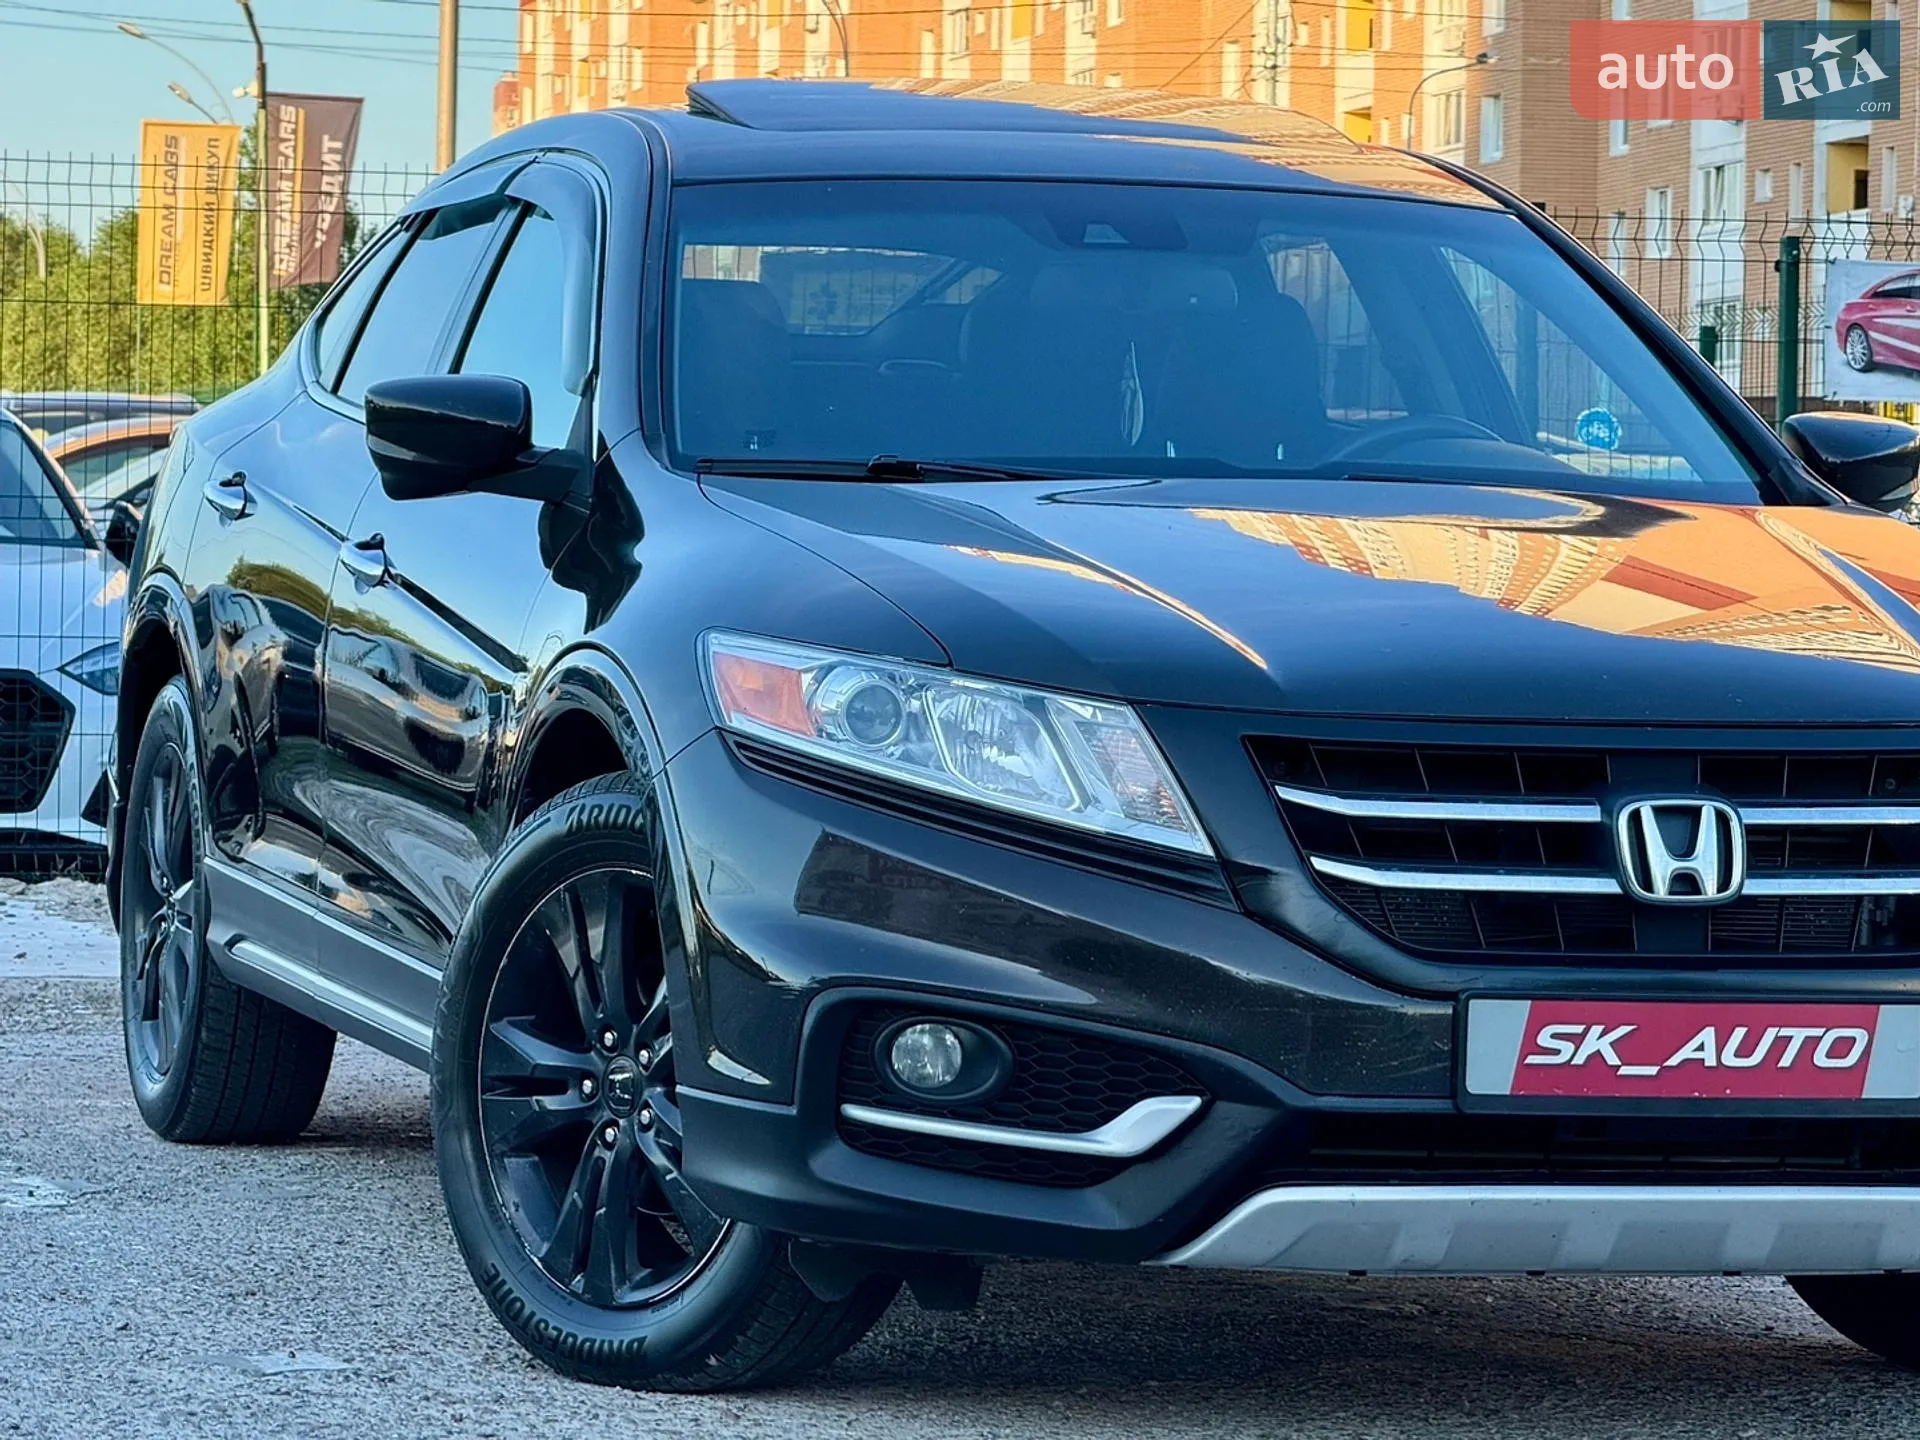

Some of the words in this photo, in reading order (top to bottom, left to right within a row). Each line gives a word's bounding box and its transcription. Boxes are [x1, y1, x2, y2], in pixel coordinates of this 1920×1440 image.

[207, 137, 220, 196] ВИКУП
[277, 104, 297, 175] CARS
[158, 204, 175, 286] DREAM
[201, 201, 216, 292] ШВИДКИЙ
[274, 180, 293, 270] DREAM
[1524, 1024, 1869, 1076] SK_AUTO
[480, 1262, 648, 1360] BRIDGESTONE
